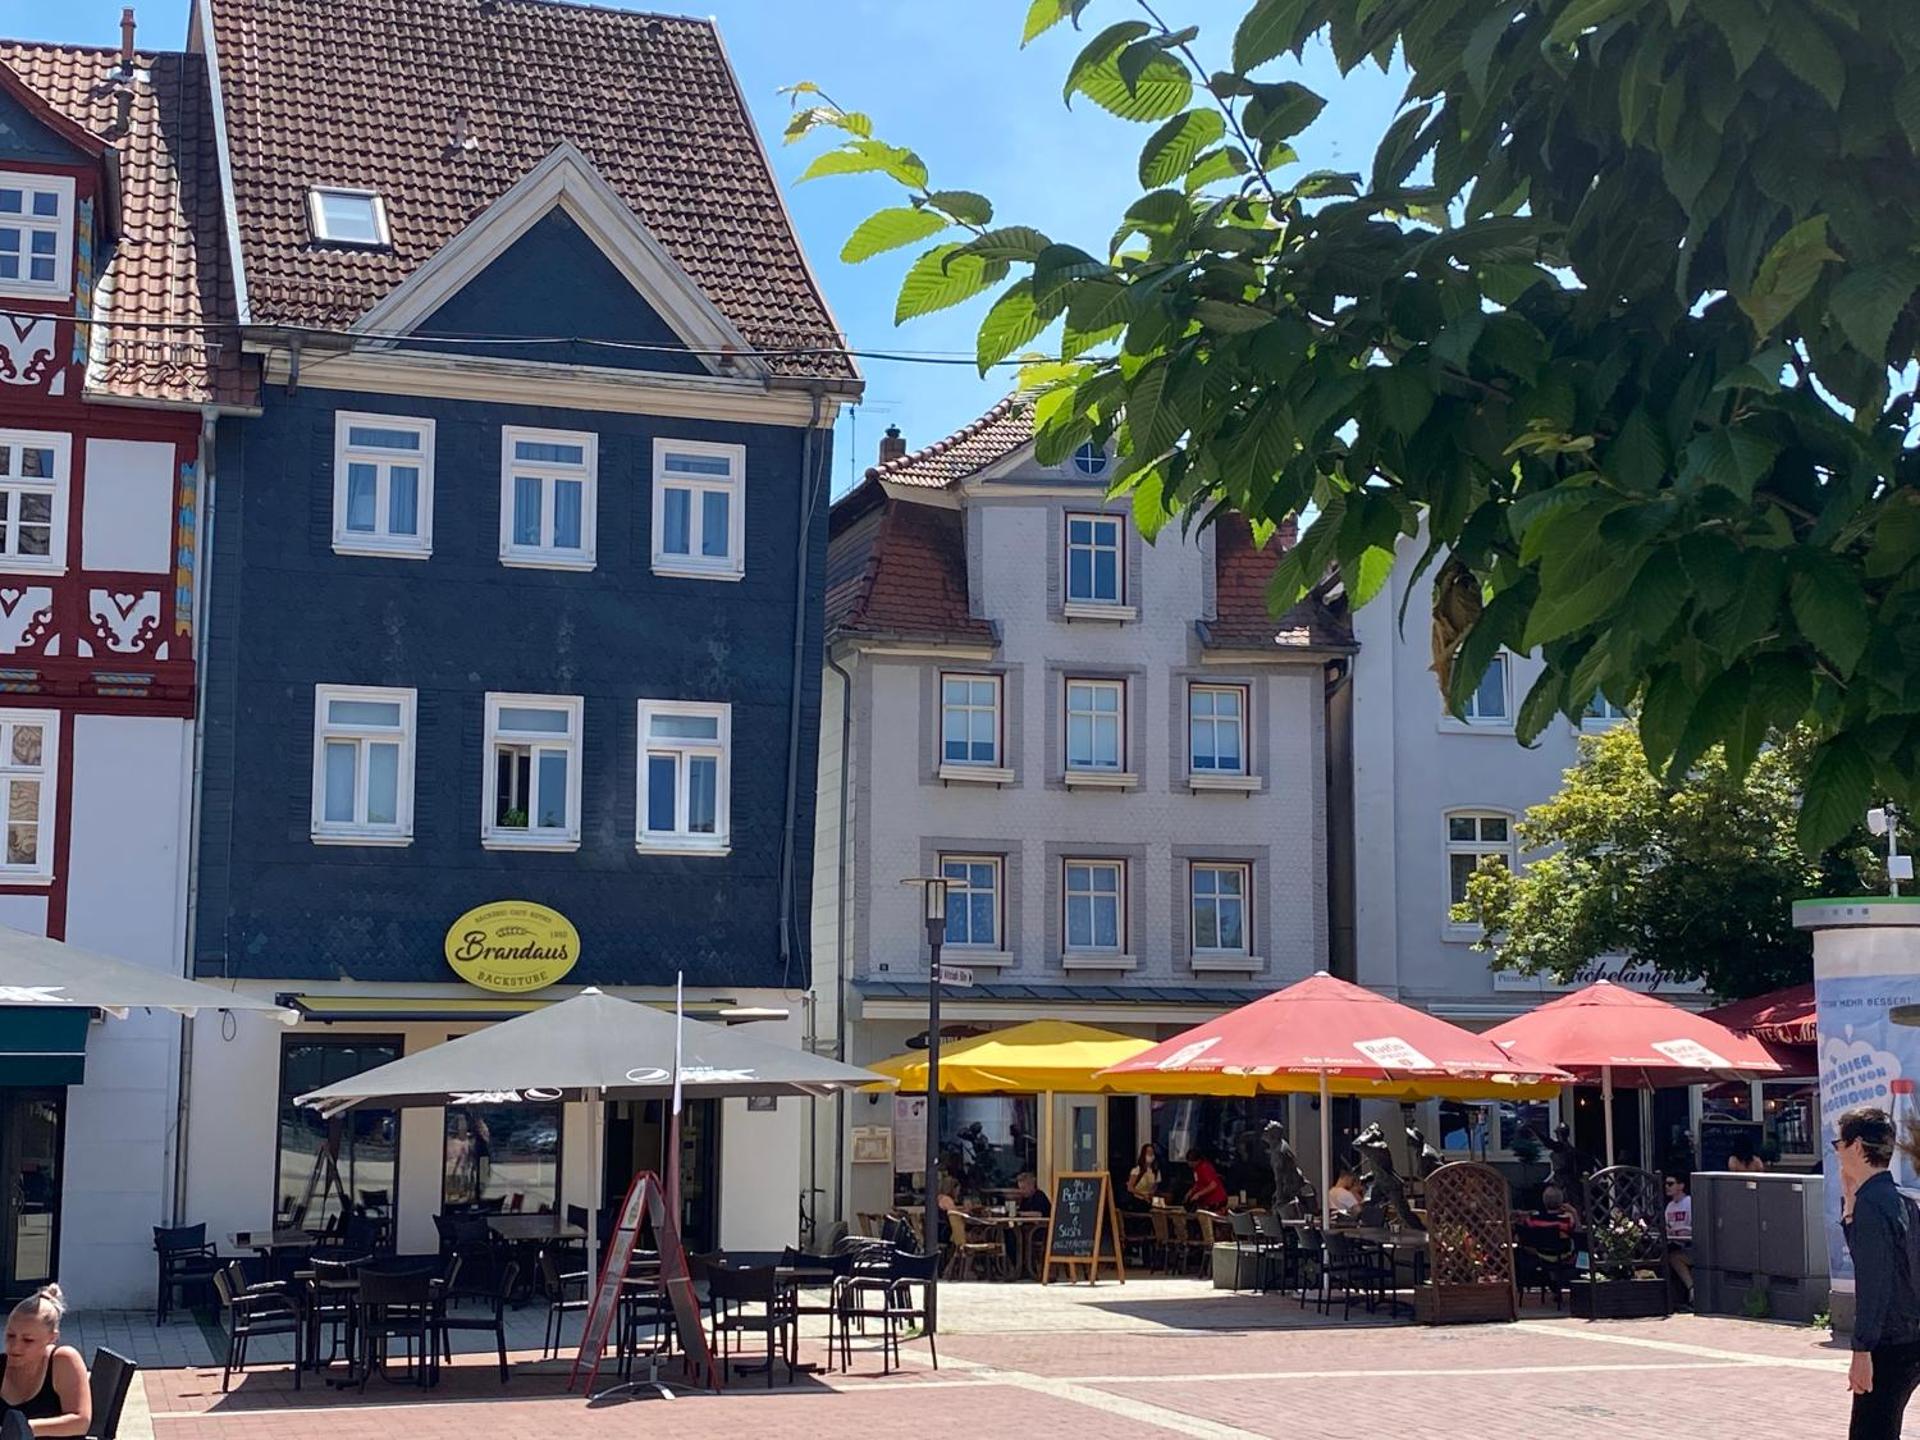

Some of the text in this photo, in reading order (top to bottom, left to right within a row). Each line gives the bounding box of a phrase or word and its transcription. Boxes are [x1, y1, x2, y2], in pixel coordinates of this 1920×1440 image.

[455, 930, 568, 962] Brandaus
[477, 971, 548, 987] BACKSTUBE
[1838, 1054, 1872, 1076] HIER
[1858, 1067, 1887, 1083] VON
